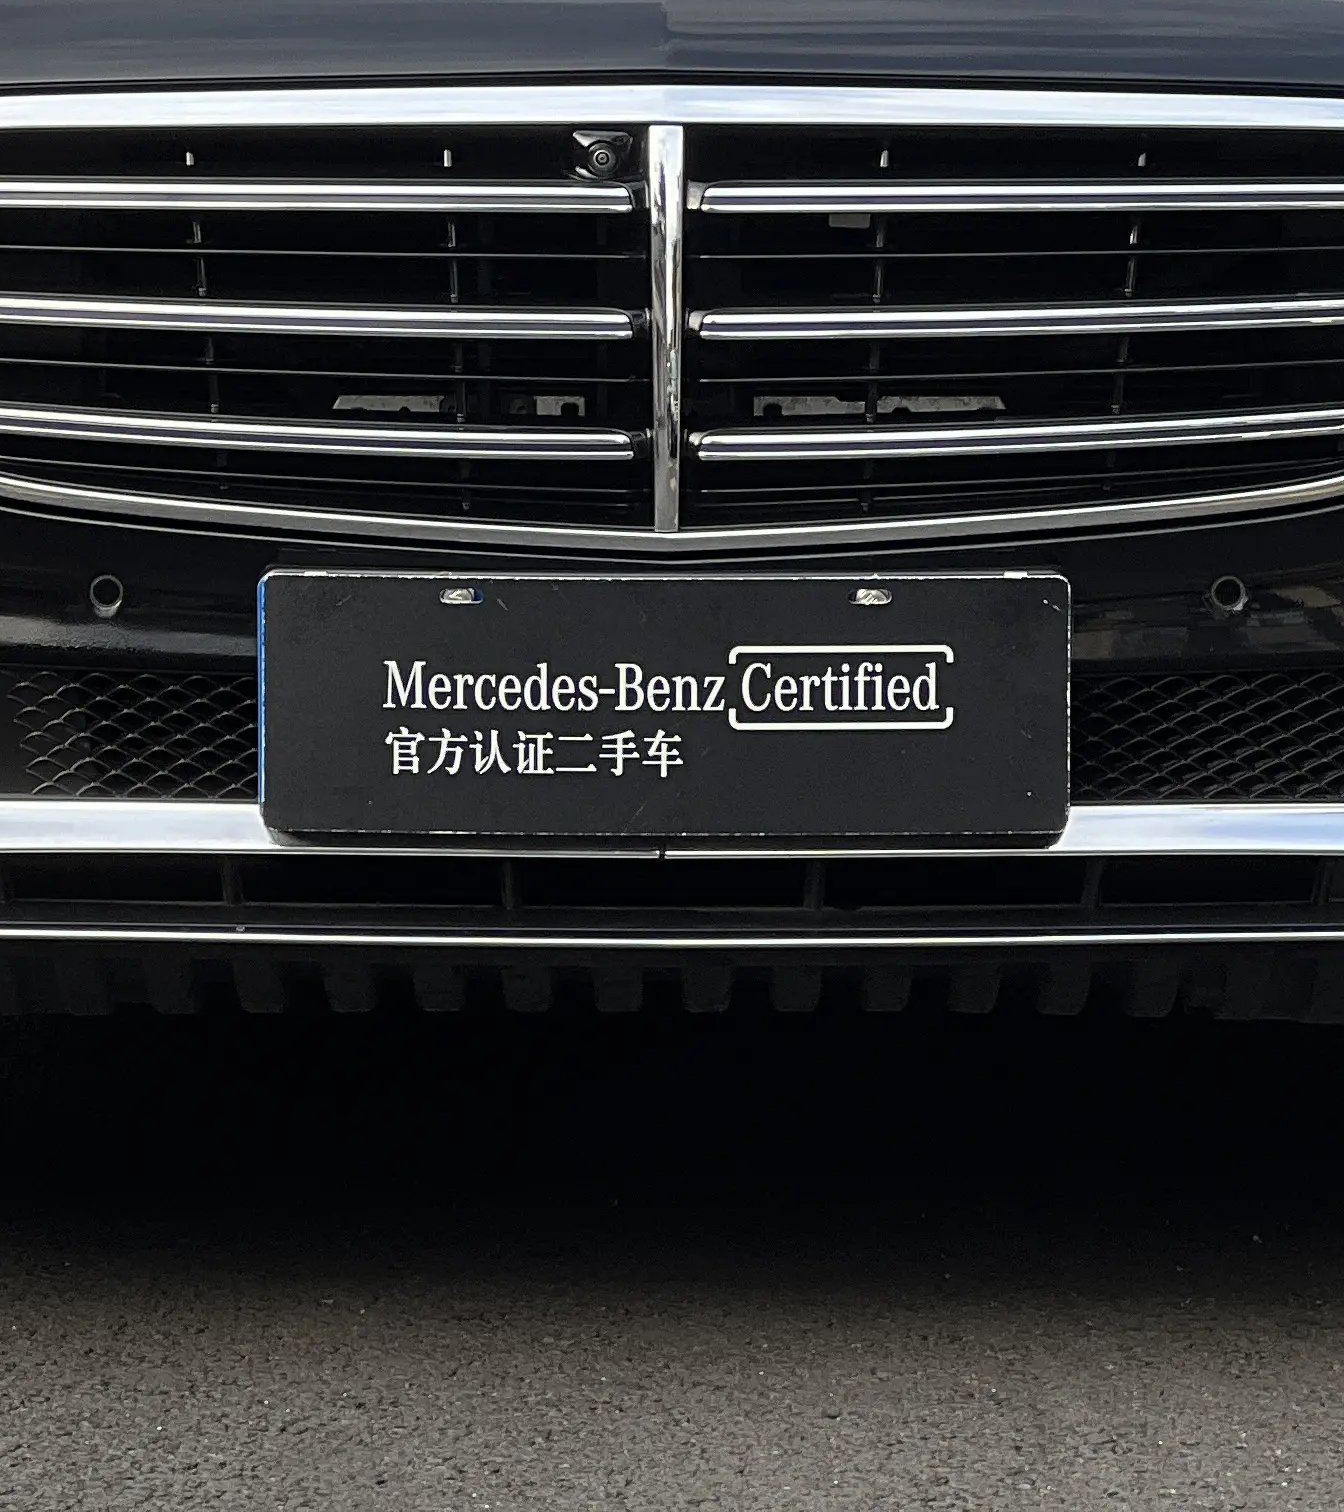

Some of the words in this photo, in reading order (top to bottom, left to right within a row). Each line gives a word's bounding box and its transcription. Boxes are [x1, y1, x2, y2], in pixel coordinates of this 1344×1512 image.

[383, 660, 727, 713] Mercedes-Benz
[741, 661, 941, 713] Certified
[384, 727, 685, 779] 官方认证二手车
